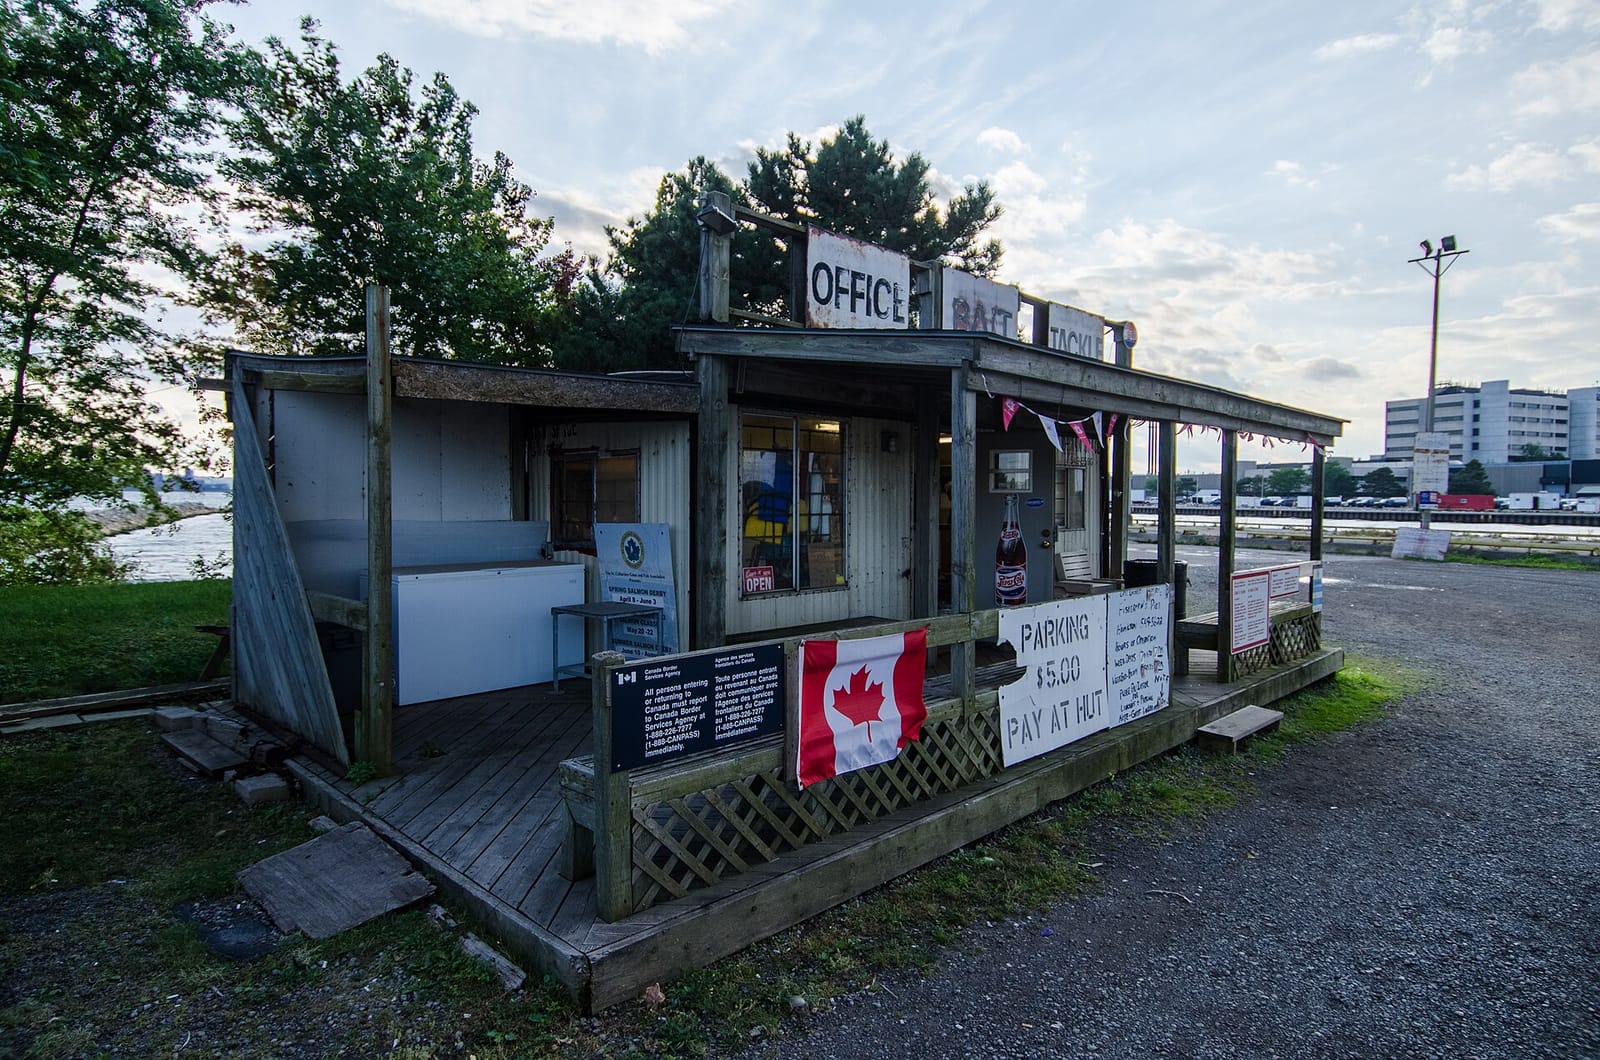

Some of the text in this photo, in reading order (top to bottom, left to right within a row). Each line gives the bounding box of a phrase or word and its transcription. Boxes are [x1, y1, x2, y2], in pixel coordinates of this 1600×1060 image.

[812, 261, 906, 323] OFFICE
[746, 576, 772, 592] OPEN
[1021, 613, 1089, 653] PARKING
[665, 670, 680, 678] Agency
[1037, 655, 1081, 690] $5.00
[656, 684, 681, 696] persons
[684, 679, 708, 690] entering
[645, 696, 707, 714] Canada must report
[654, 692, 683, 704] returning
[645, 712, 705, 731] Services Agency at
[654, 710, 678, 721] Canada
[680, 705, 701, 715] Border
[1007, 689, 1103, 750] PAY AT HUT
